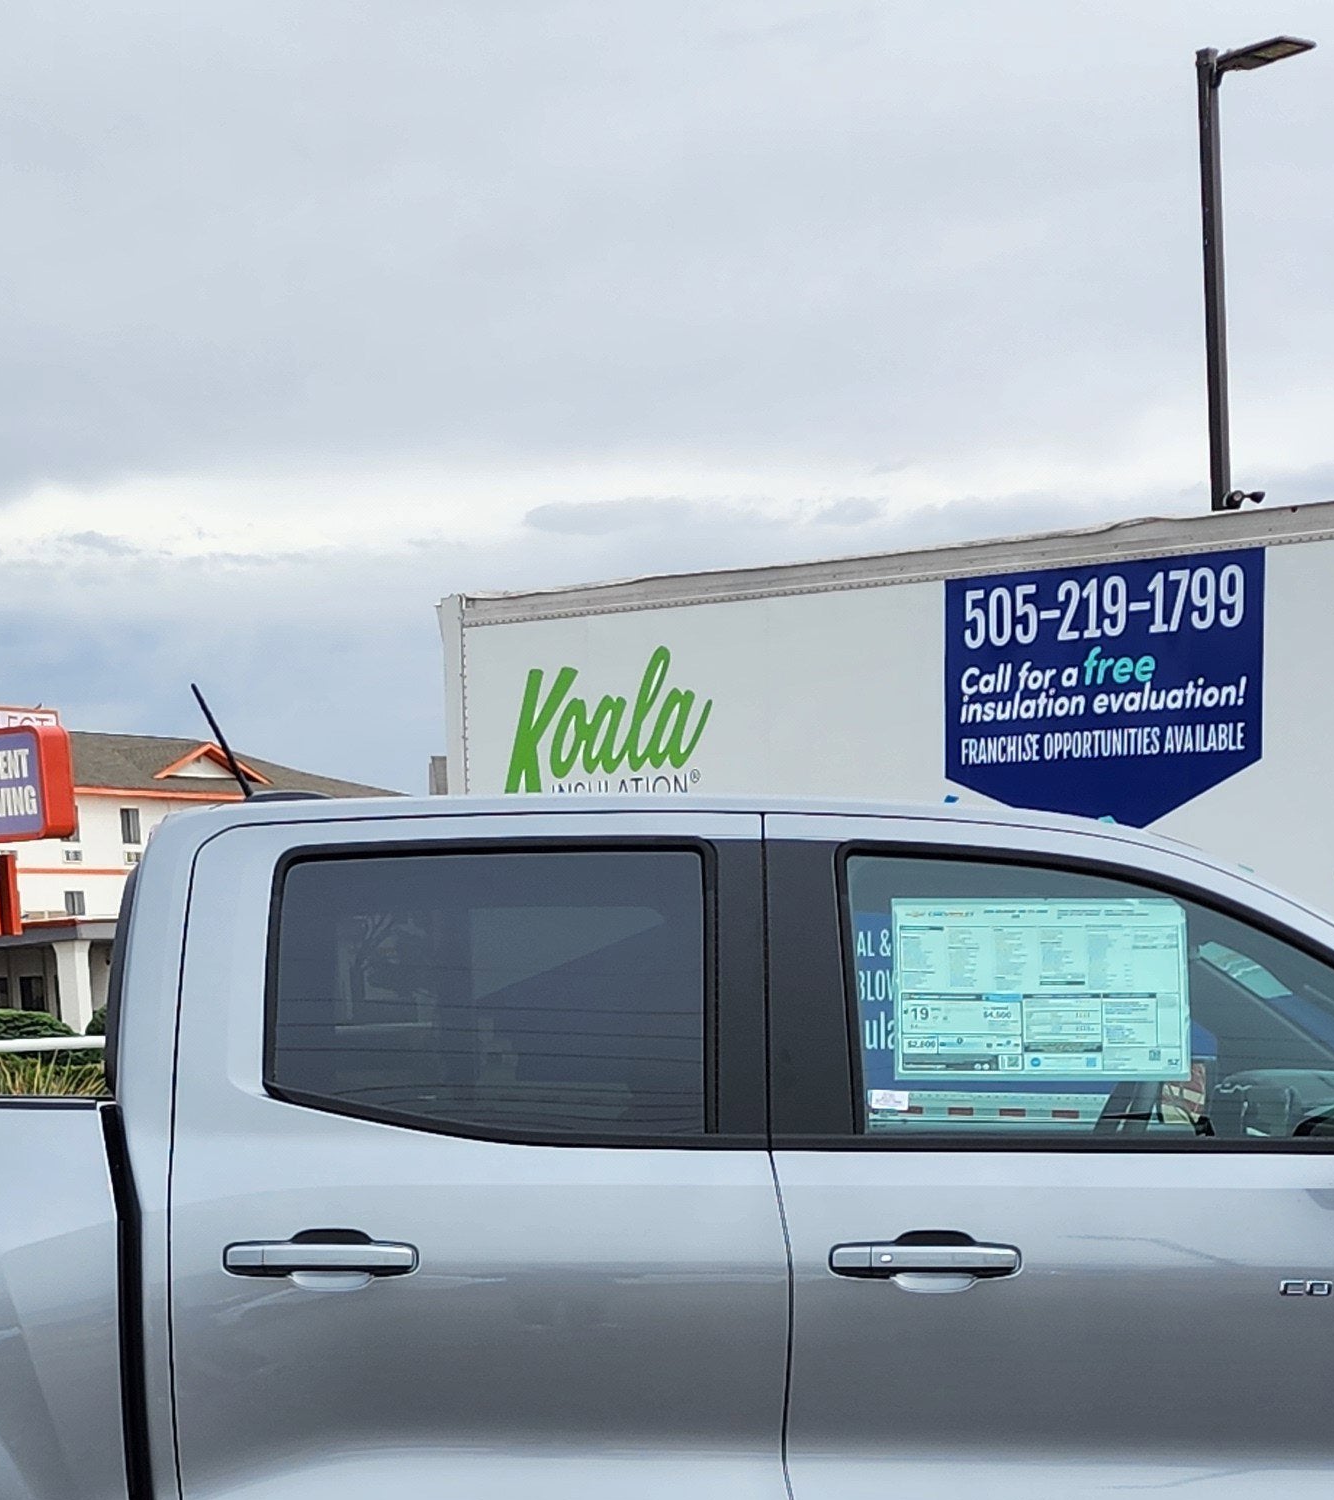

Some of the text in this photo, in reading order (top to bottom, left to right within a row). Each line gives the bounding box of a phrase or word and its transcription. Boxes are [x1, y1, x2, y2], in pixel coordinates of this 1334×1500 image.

[963, 564, 1245, 649] 505-219-1799
[960, 646, 1156, 695] Call for a free
[504, 645, 713, 794] Koala
[960, 676, 1248, 724] insulation evaluation!
[961, 722, 1246, 765] FRANCHISE OPPORTUNITIES AVAILABLE
[879, 929, 892, 957] &
